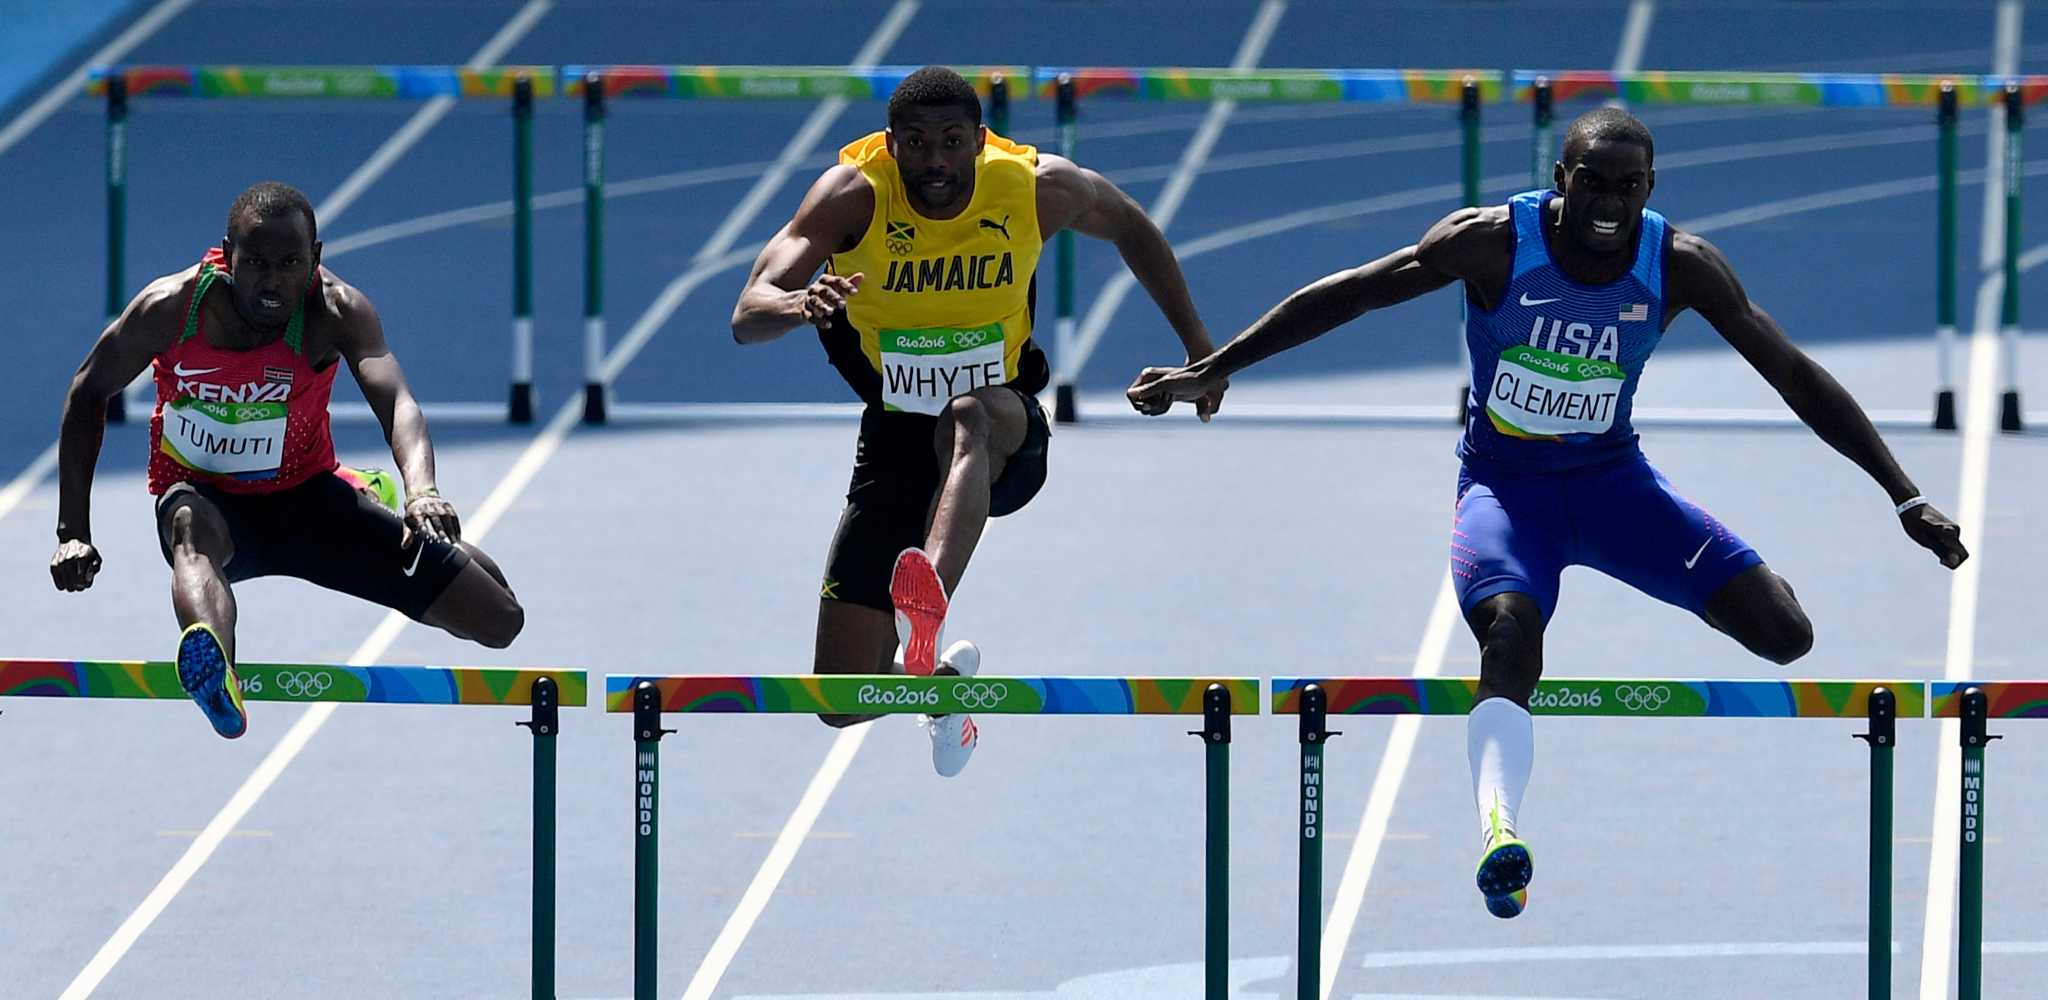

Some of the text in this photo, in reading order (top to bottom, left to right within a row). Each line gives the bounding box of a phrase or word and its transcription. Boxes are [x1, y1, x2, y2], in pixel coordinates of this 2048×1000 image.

[882, 252, 1014, 293] JAMAICA
[896, 336, 945, 348] Rio2016
[1529, 316, 1619, 363] USA
[177, 379, 291, 402] KENYA
[885, 361, 1001, 398] WHYTE
[1495, 371, 1617, 422] CLEMENT
[177, 414, 273, 455] TUMUTI
[858, 684, 939, 704] Rio2016
[638, 770, 655, 836] MONDO
[1304, 773, 1320, 838] MONDO
[1964, 777, 1980, 843] MONDO
